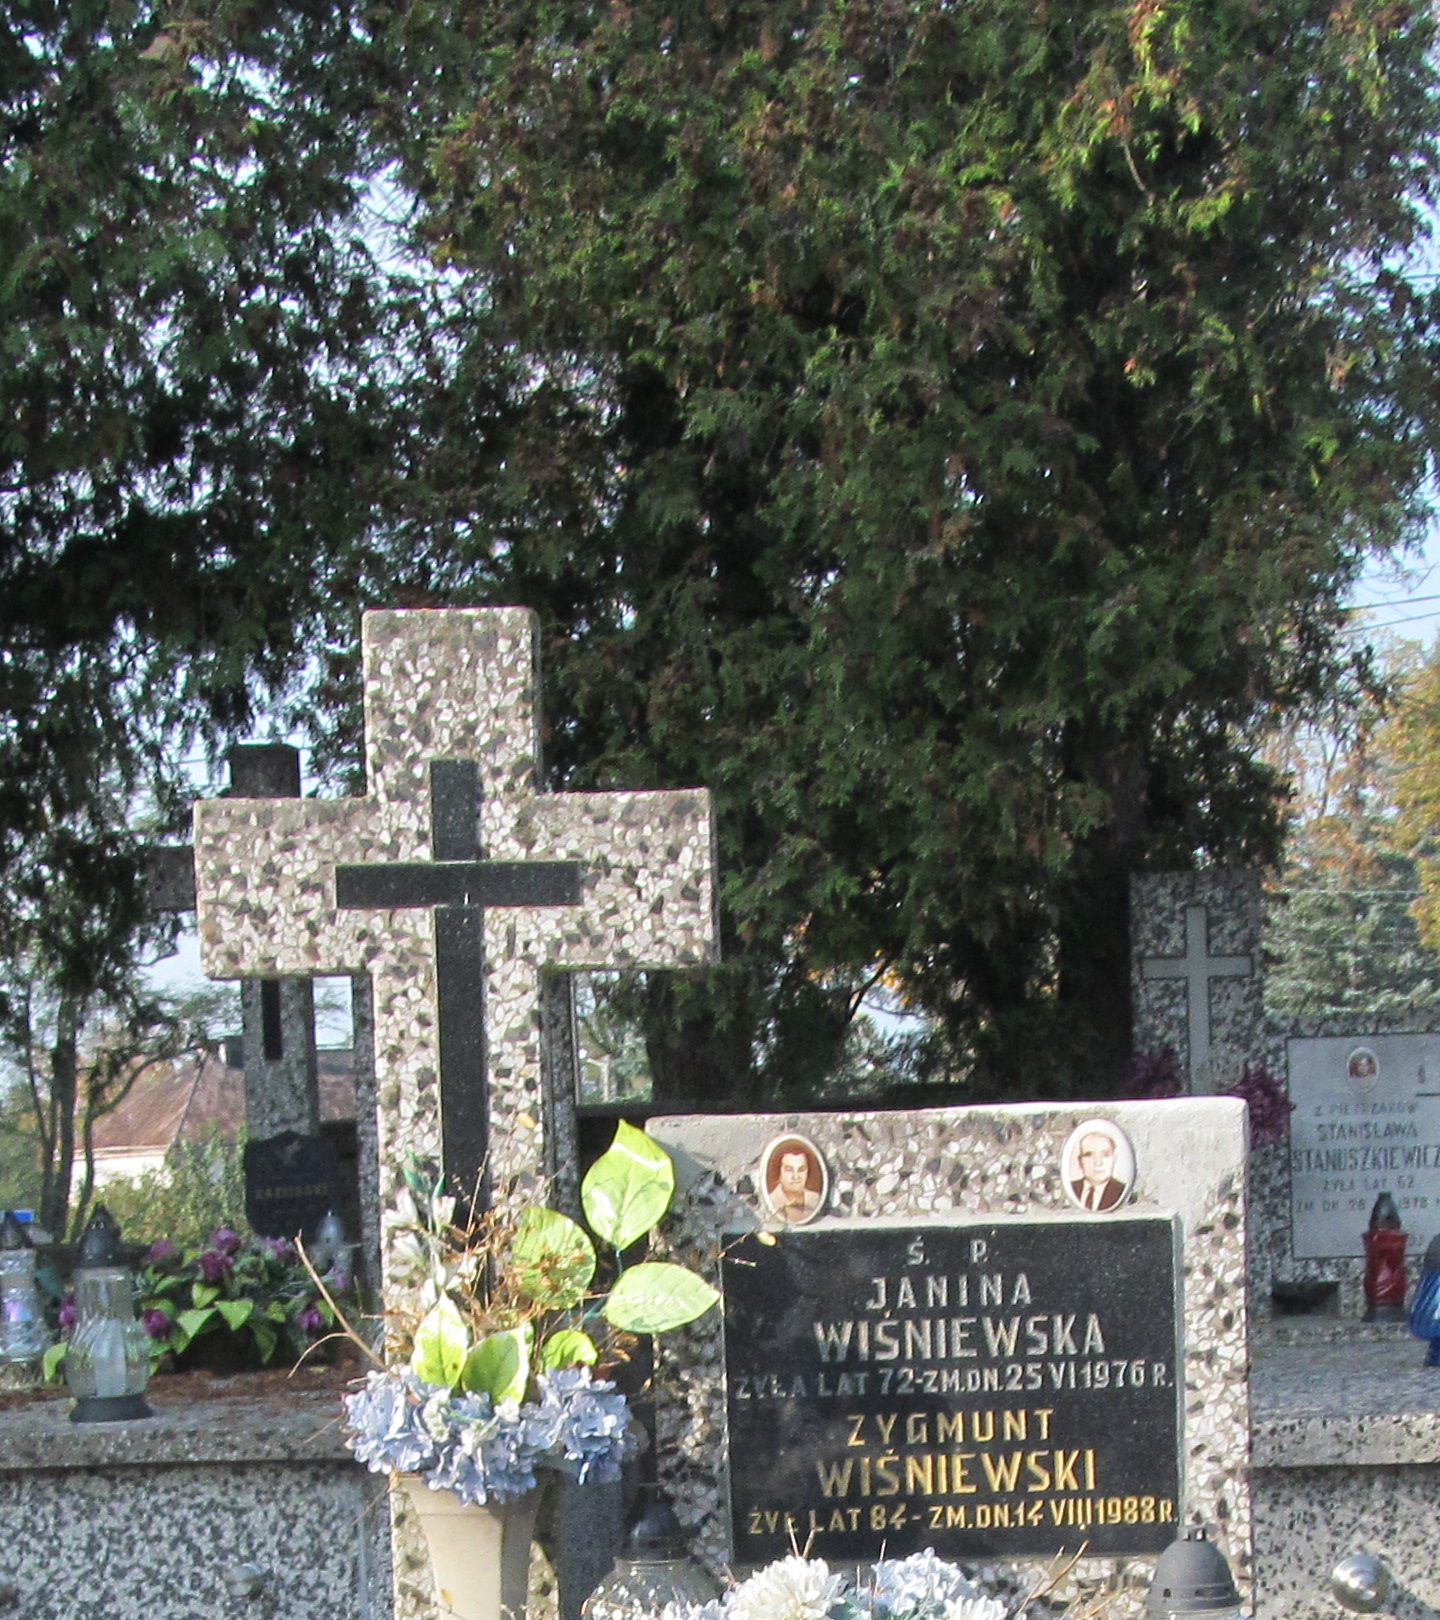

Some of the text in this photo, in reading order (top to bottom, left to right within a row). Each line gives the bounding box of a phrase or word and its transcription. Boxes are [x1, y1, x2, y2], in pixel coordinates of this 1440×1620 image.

[969, 1238, 988, 1264] P.
[865, 1272, 1032, 1311] JANINA
[813, 1309, 1106, 1364] WIŚNIEWSKA
[817, 1370, 870, 1397] LAT
[846, 1408, 1054, 1447] ZYGMUNT
[815, 1447, 1097, 1498] WIŚNIEWSKI
[808, 1507, 862, 1533] LAT
[869, 1502, 908, 1532] 84
[1093, 1494, 1157, 1526] 1988
